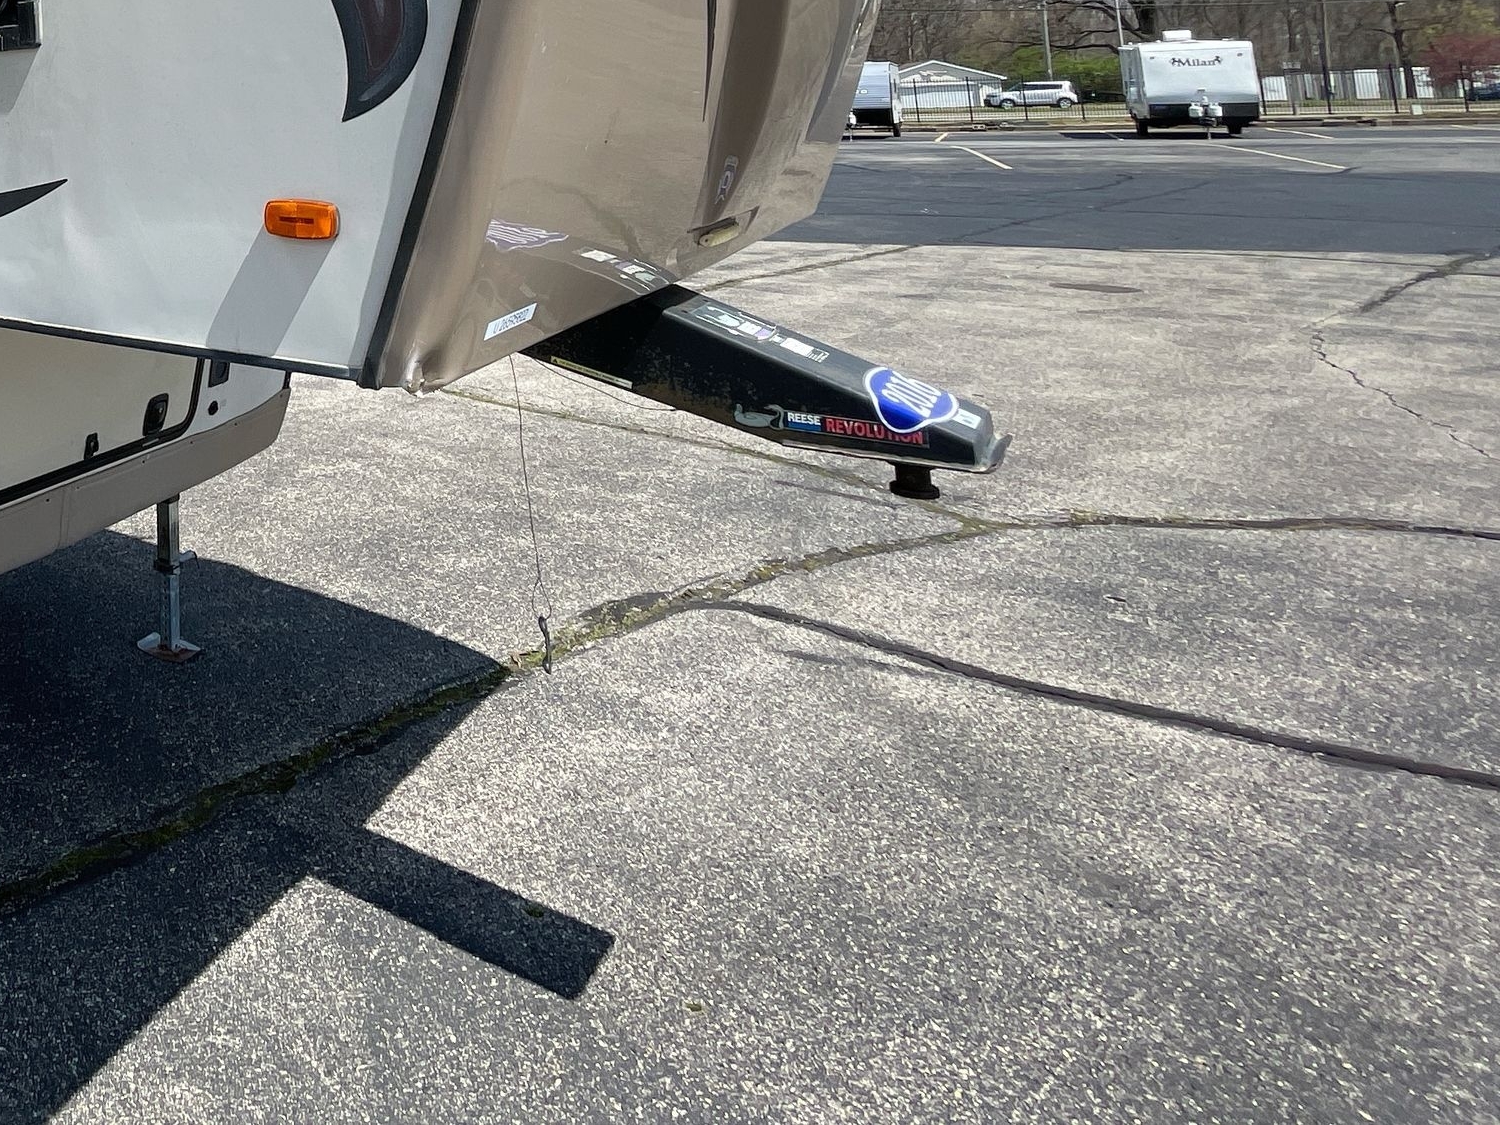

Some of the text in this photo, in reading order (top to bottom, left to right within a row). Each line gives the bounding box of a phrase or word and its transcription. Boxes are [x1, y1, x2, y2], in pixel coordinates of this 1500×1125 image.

[1177, 57, 1216, 67] Milan
[881, 370, 942, 418] 2016
[787, 411, 822, 426] REESE
